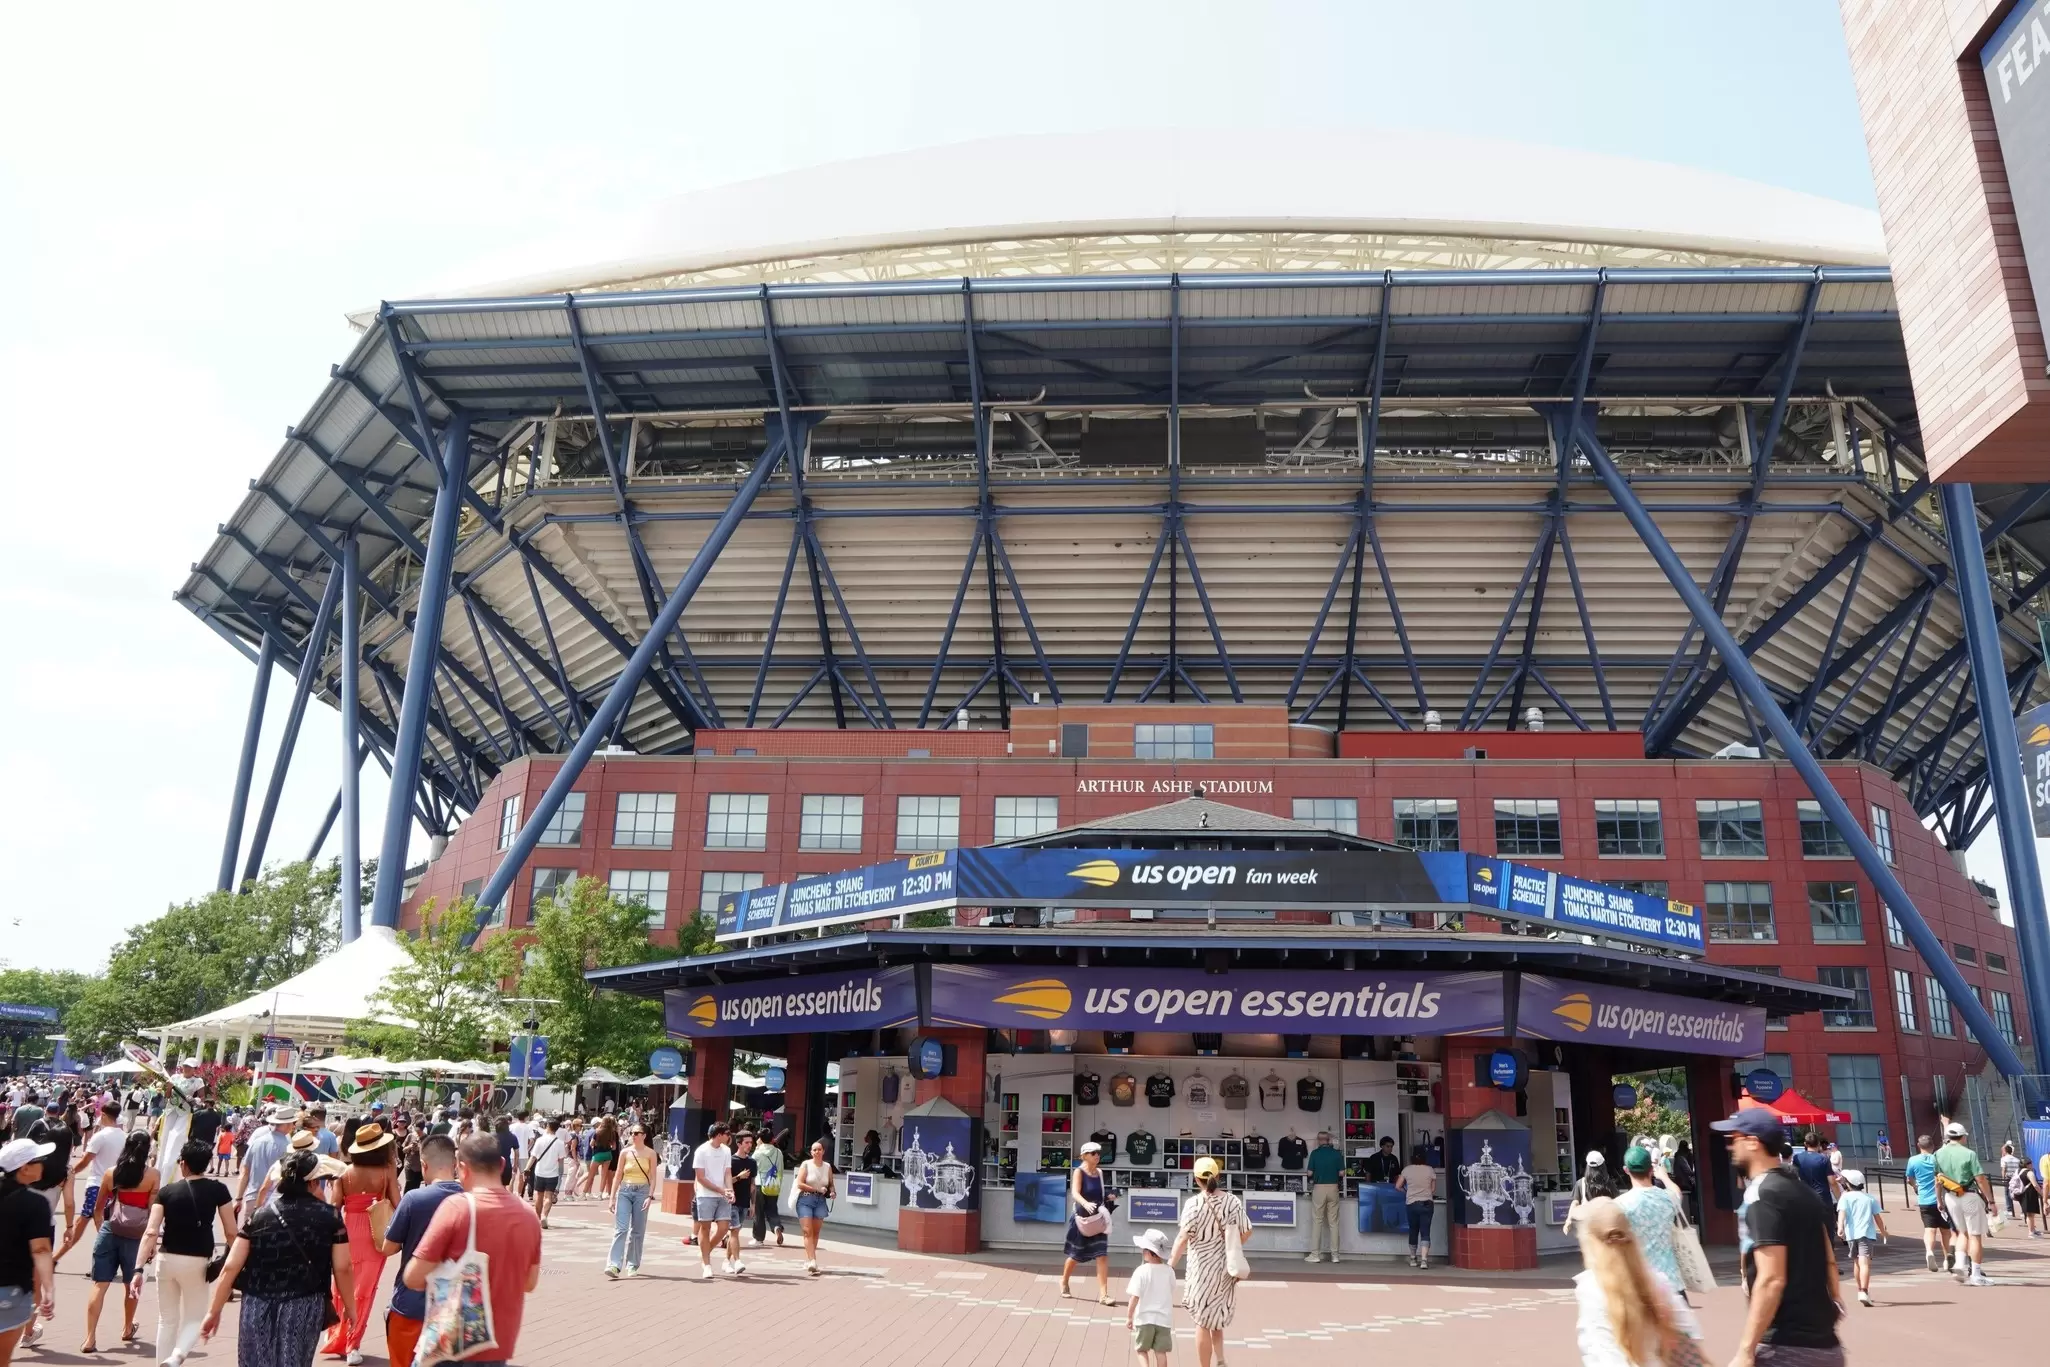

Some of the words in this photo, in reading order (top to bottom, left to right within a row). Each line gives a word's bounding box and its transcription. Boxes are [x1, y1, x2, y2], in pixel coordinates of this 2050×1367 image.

[1077, 780, 1145, 793] ARTHUR
[1151, 780, 1193, 793] ASHE
[1199, 780, 1273, 793] STADIUM
[915, 855, 933, 867] COURT
[902, 874, 931, 896] 12:30
[934, 870, 952, 891] PM
[1131, 865, 1164, 884] us
[1166, 865, 1237, 890] open
[1246, 868, 1272, 884] fan
[1277, 868, 1318, 884] week
[1513, 875, 1546, 893] PRACTICE
[790, 882, 832, 903] JUNCHENG
[835, 876, 863, 892] SHANG
[1481, 885, 1497, 896] open
[1512, 889, 1545, 906] SCHEDULE
[1563, 884, 1605, 908] JUNCHENG
[1608, 895, 1634, 913] SHANG
[750, 894, 777, 909] PRACTICE
[790, 902, 813, 918] TOMAS
[814, 896, 843, 914] MARTIN
[844, 886, 896, 908] ETCHEVERRY
[1672, 903, 1685, 912] COURT
[727, 916, 737, 926] open
[747, 907, 775, 921] SCHEDULE
[1563, 901, 1589, 919] TOMAS
[1591, 907, 1618, 926] MARTIN
[1619, 913, 1661, 934] ETCHEVERRY
[1664, 918, 1686, 937] 12:30
[1688, 923, 1701, 941] PM
[722, 998, 739, 1021] us
[741, 995, 782, 1027] open
[785, 978, 882, 1017] essentials
[1084, 988, 1130, 1014] us
[1133, 988, 1232, 1024] open
[1240, 982, 1441, 1018] essentials
[1597, 1004, 1620, 1028] us
[1620, 1007, 1665, 1039] open
[1666, 1012, 1745, 1043] essentials
